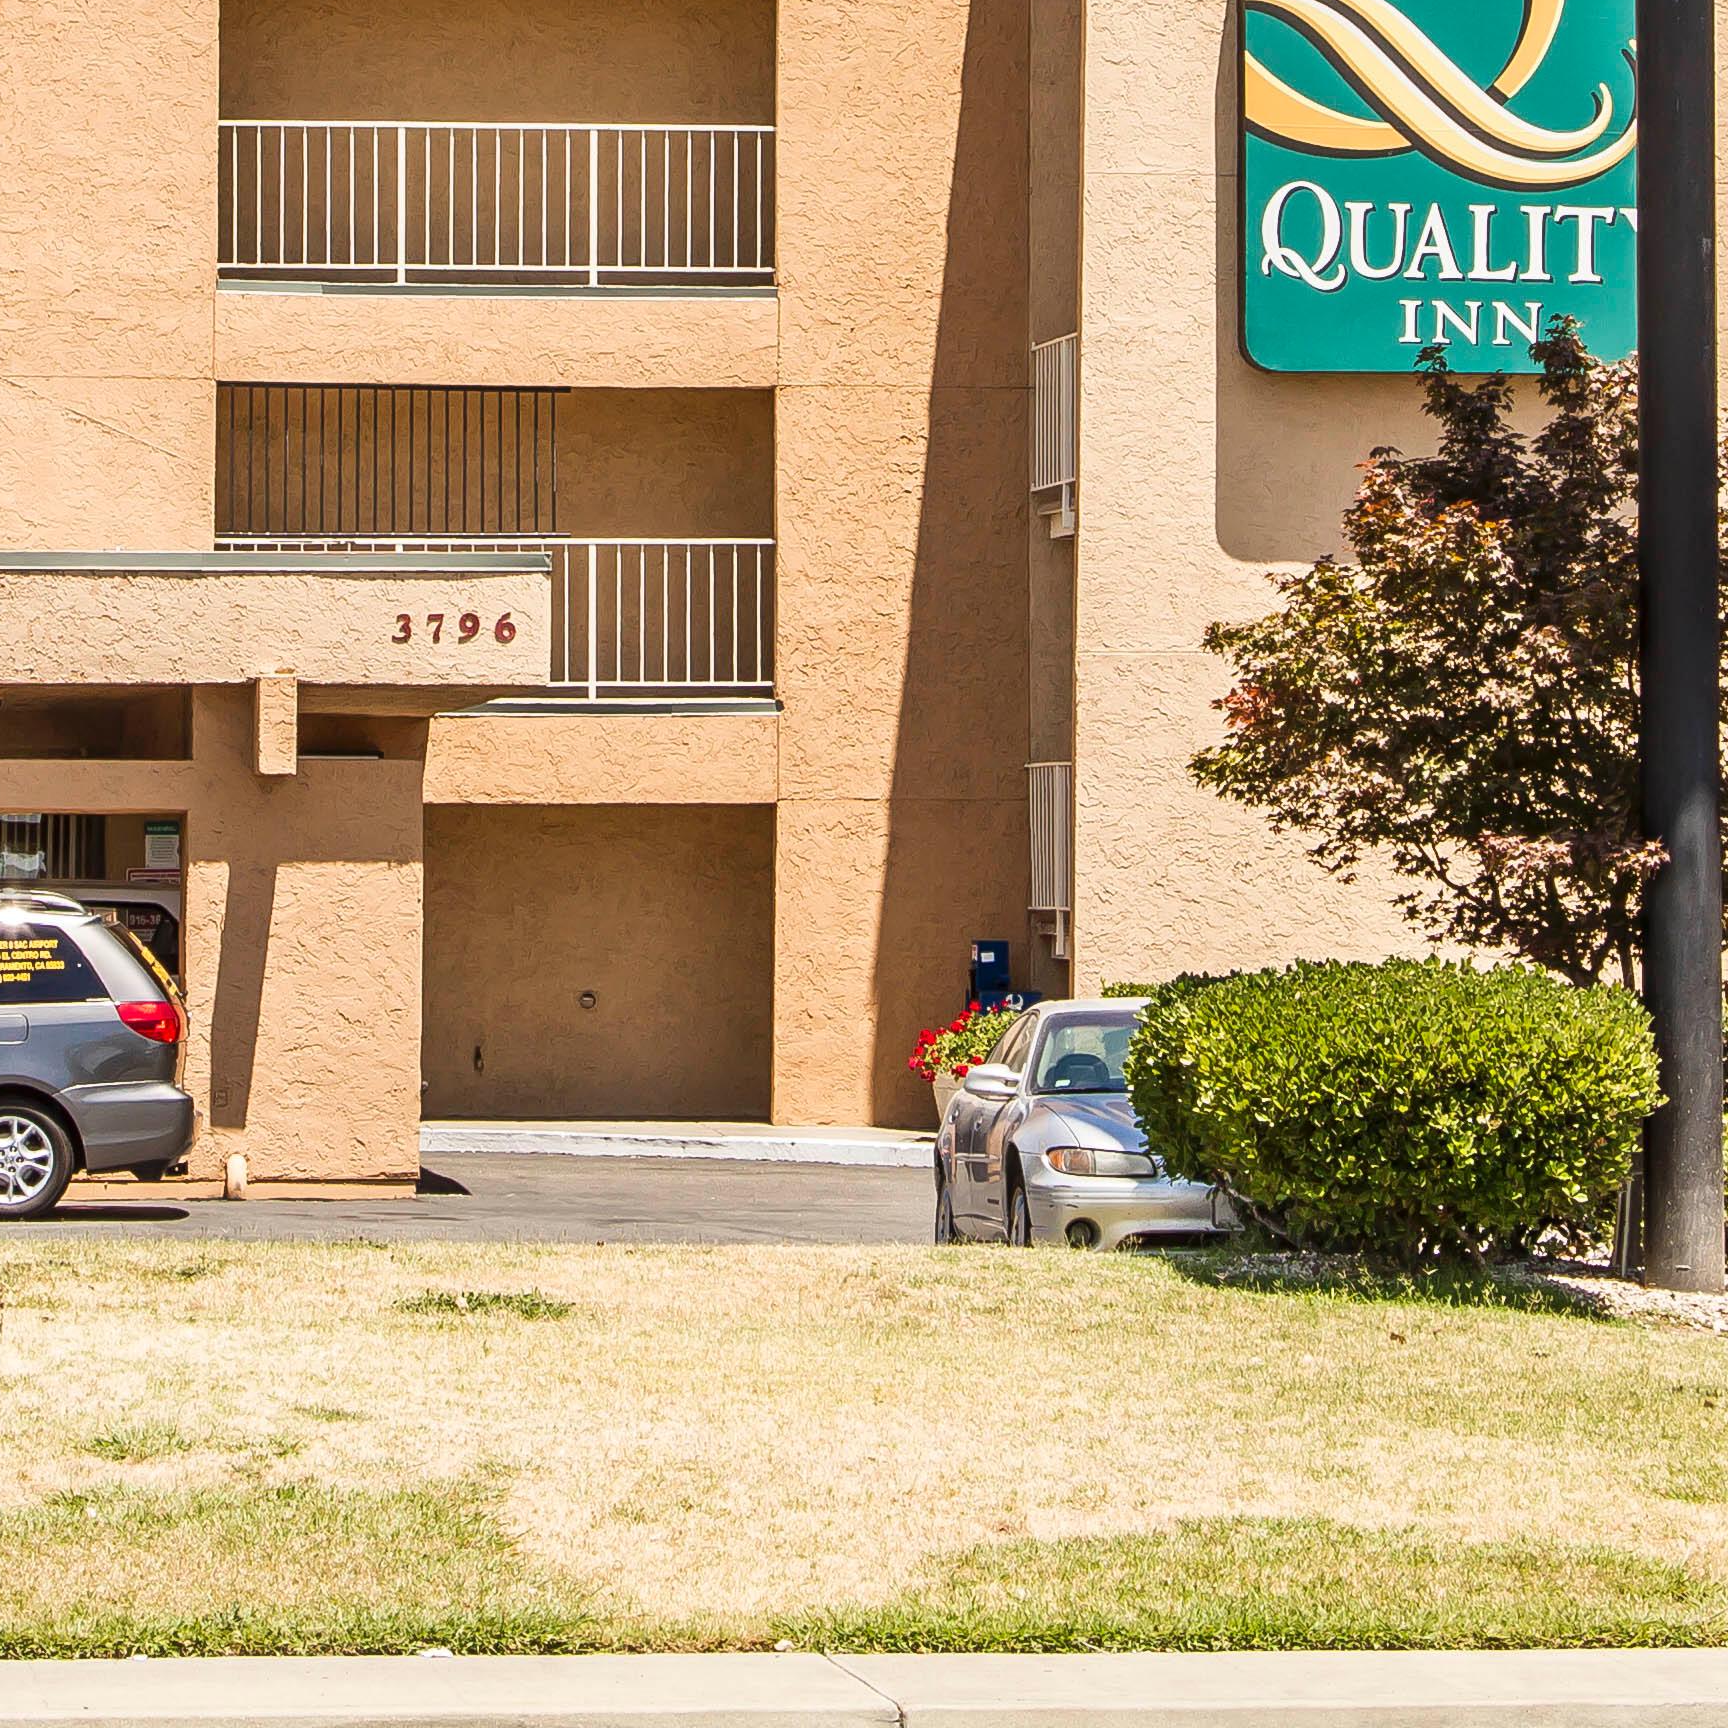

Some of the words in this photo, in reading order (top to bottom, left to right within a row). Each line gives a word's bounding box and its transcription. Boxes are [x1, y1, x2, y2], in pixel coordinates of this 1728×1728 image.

[1260, 179, 1638, 294] QUALIT
[1397, 298, 1545, 347] INN
[391, 612, 517, 645] 3796
